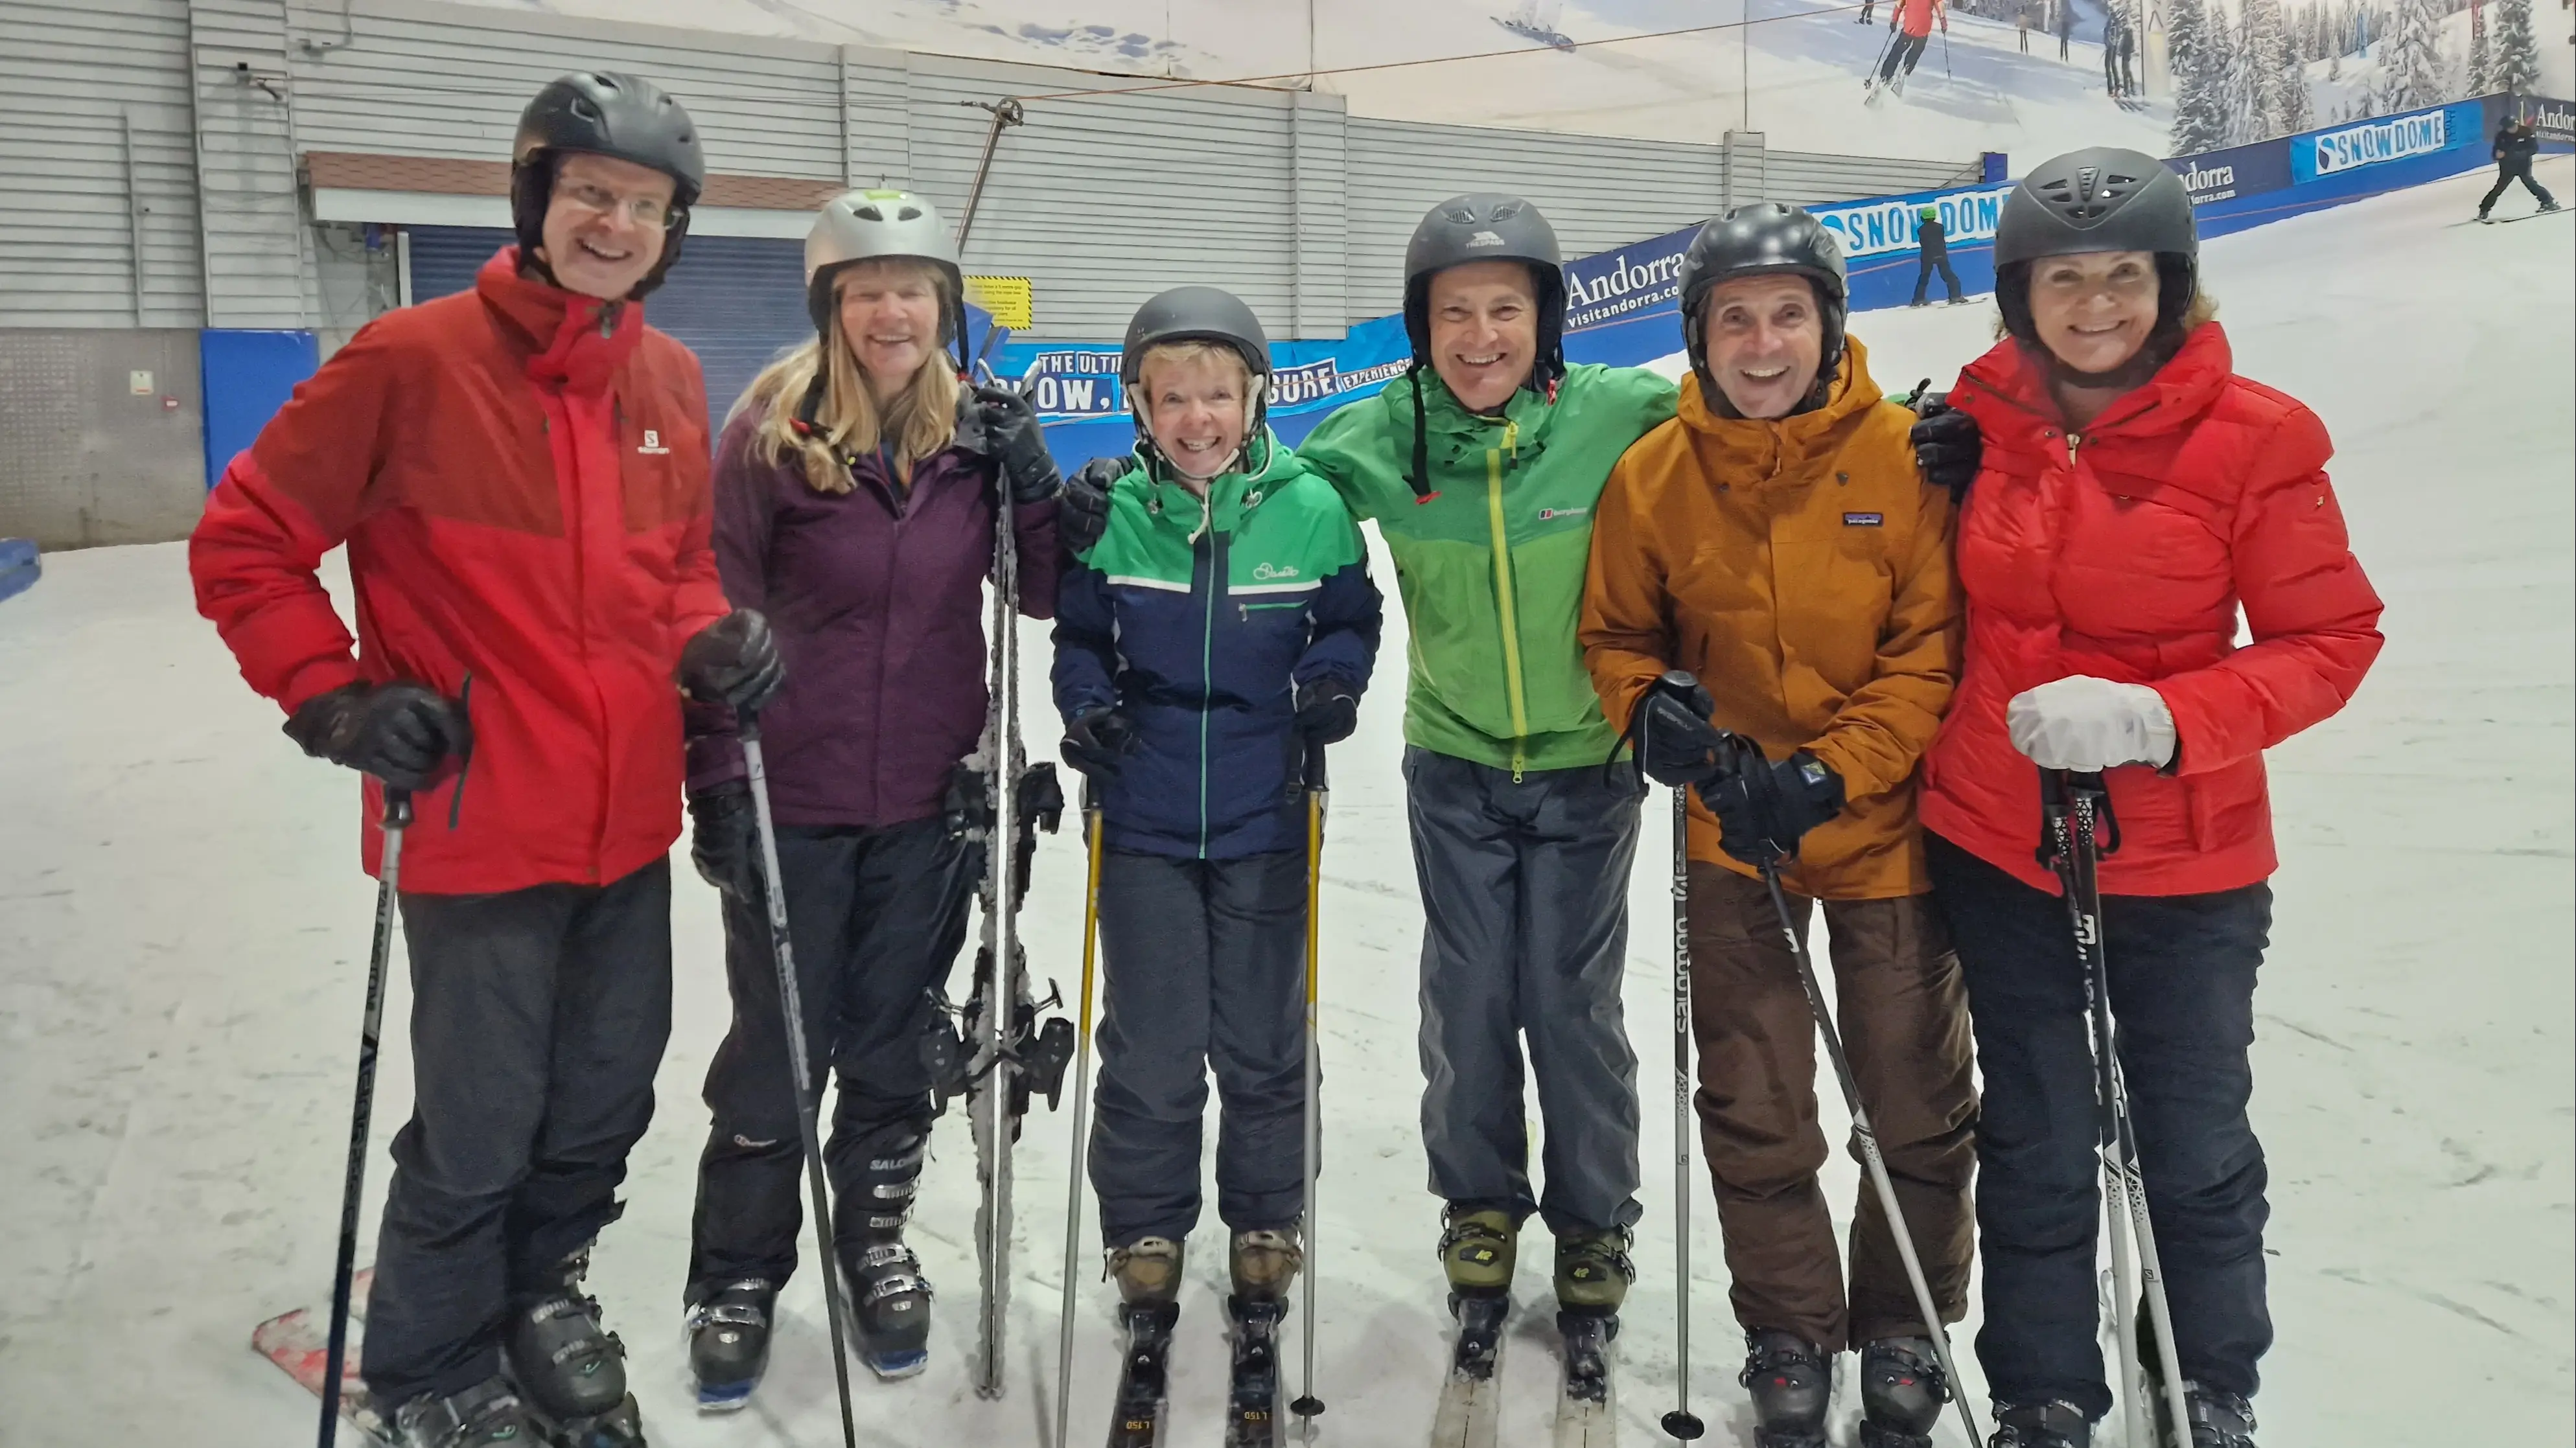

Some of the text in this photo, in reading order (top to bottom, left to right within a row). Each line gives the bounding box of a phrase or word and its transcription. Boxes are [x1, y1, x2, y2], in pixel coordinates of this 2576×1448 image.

[2338, 117, 2442, 165] SNOWDOME
[2177, 161, 2234, 192] dorra
[1848, 194, 2009, 251] SNOWDOM
[1566, 253, 1685, 311] Andorra
[1568, 285, 1680, 328] visitandorra.co
[1040, 356, 1074, 373] THE
